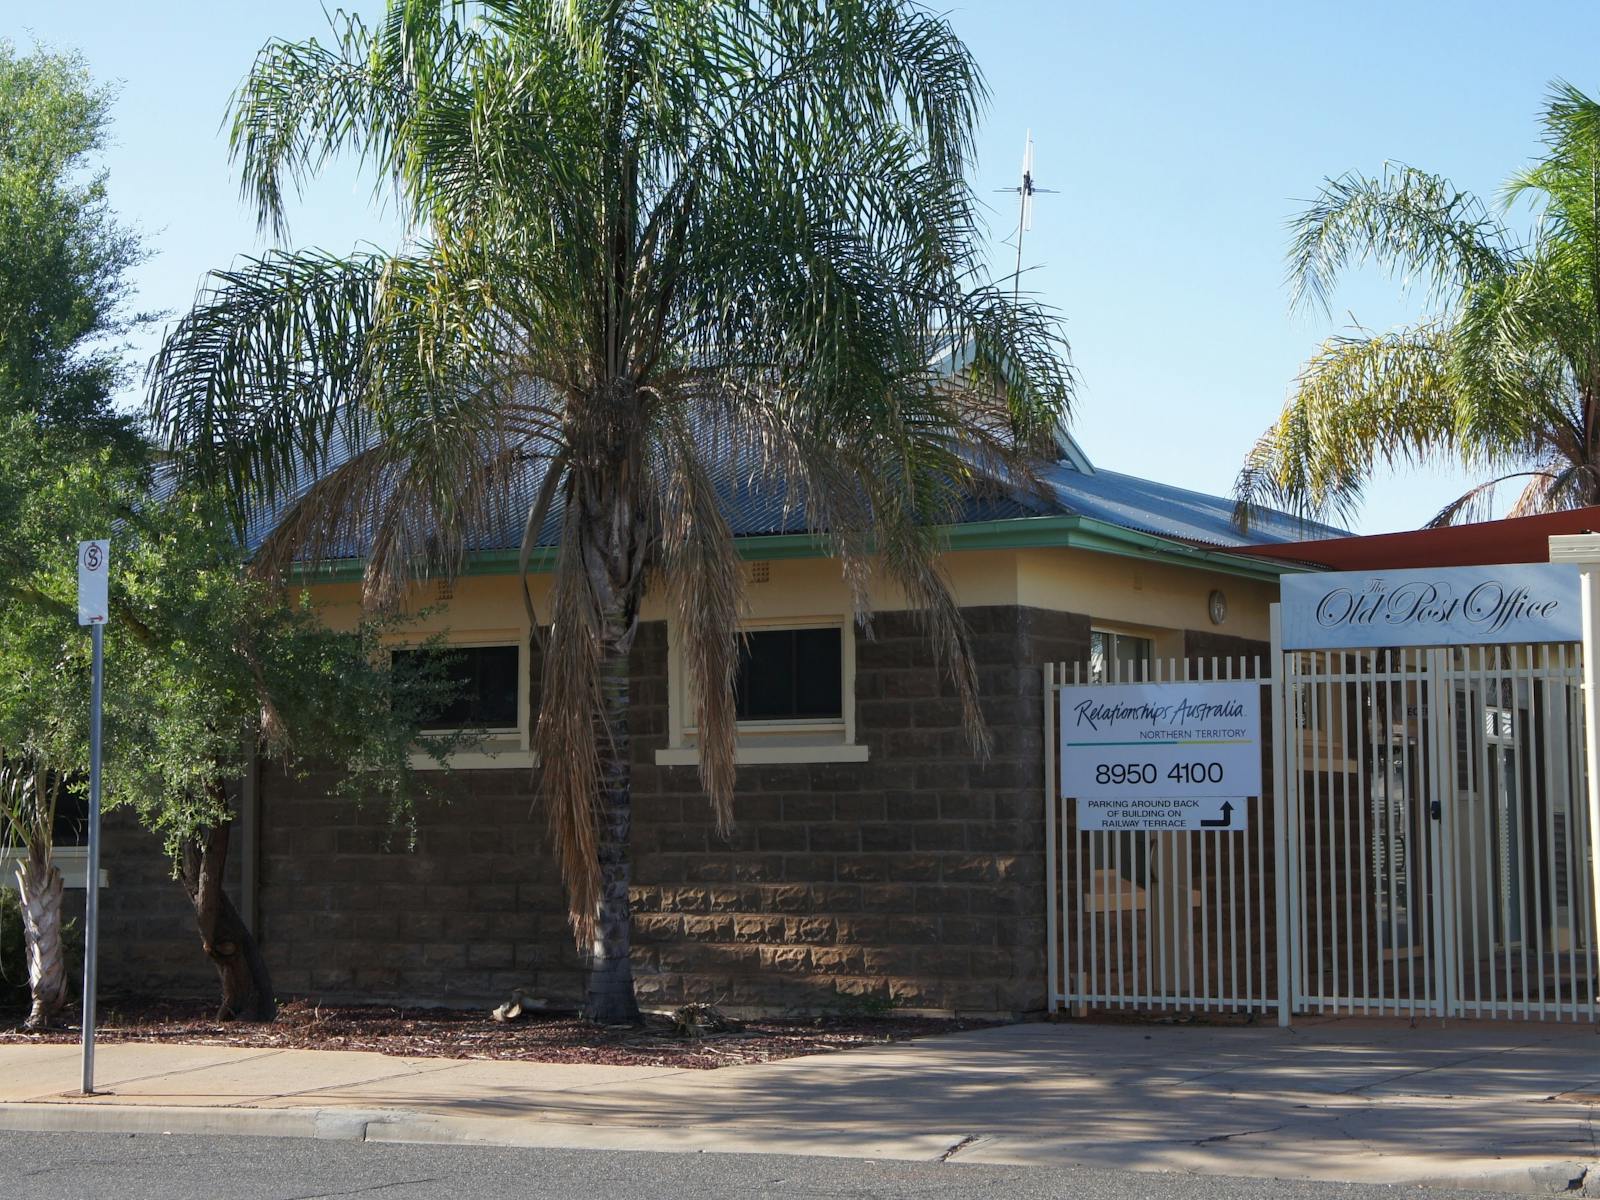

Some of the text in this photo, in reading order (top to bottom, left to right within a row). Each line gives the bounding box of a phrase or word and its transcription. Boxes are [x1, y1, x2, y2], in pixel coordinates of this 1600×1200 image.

[1363, 578, 1388, 593] The
[1316, 580, 1558, 635] Old Post Office
[1074, 698, 1244, 731] Relationships Australia
[1140, 729, 1247, 739] NORTHERN TERRITORY
[1096, 762, 1223, 784] 8950 4100
[1088, 800, 1129, 808] PARKING
[1131, 800, 1171, 808] AROUND
